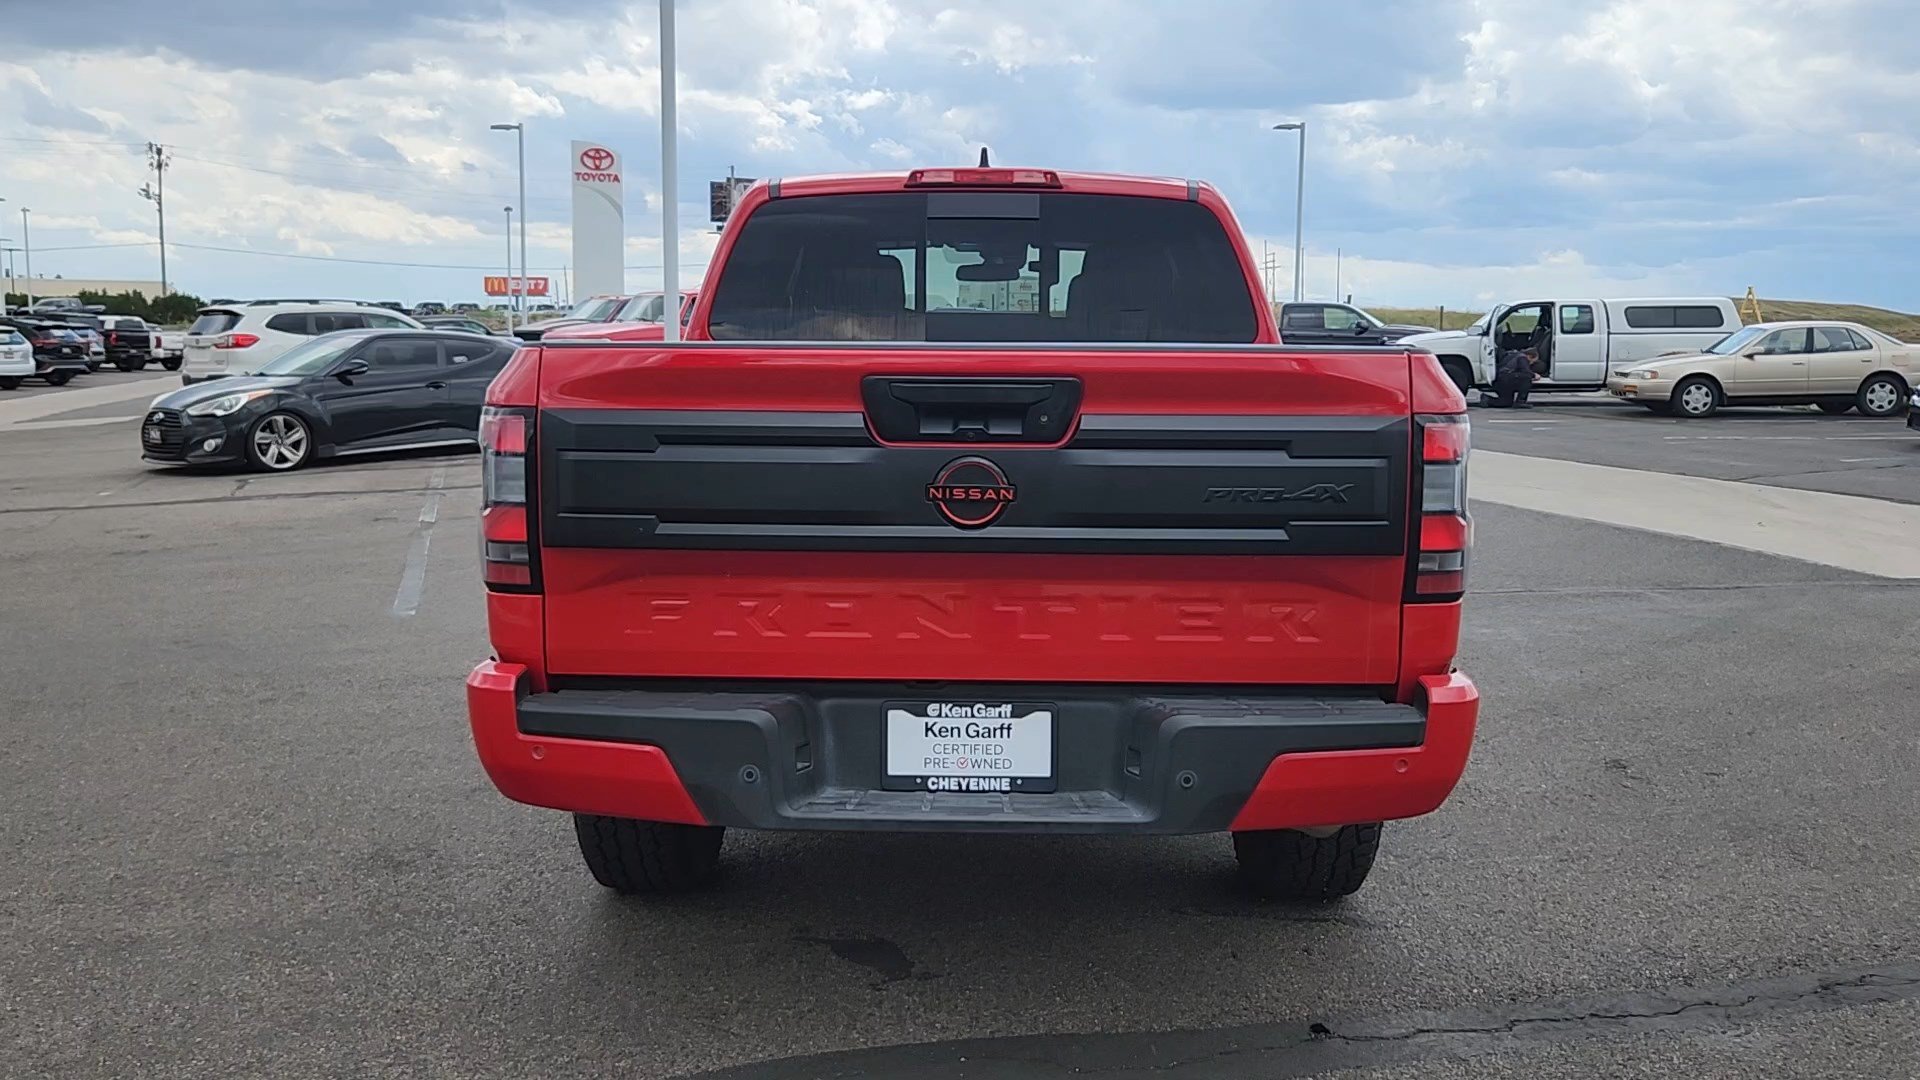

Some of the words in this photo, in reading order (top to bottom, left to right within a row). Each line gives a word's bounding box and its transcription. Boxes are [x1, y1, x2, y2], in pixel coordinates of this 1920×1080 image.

[574, 172, 621, 183] TOYOTA
[510, 280, 537, 290] EXT
[929, 487, 1014, 500] NISSAN
[1202, 483, 1355, 503] PRO-4X
[924, 722, 961, 738] Ken
[965, 723, 1013, 739] Garff
[932, 743, 1004, 756] CERTIFIED
[927, 777, 1011, 791] CHEYENNE
